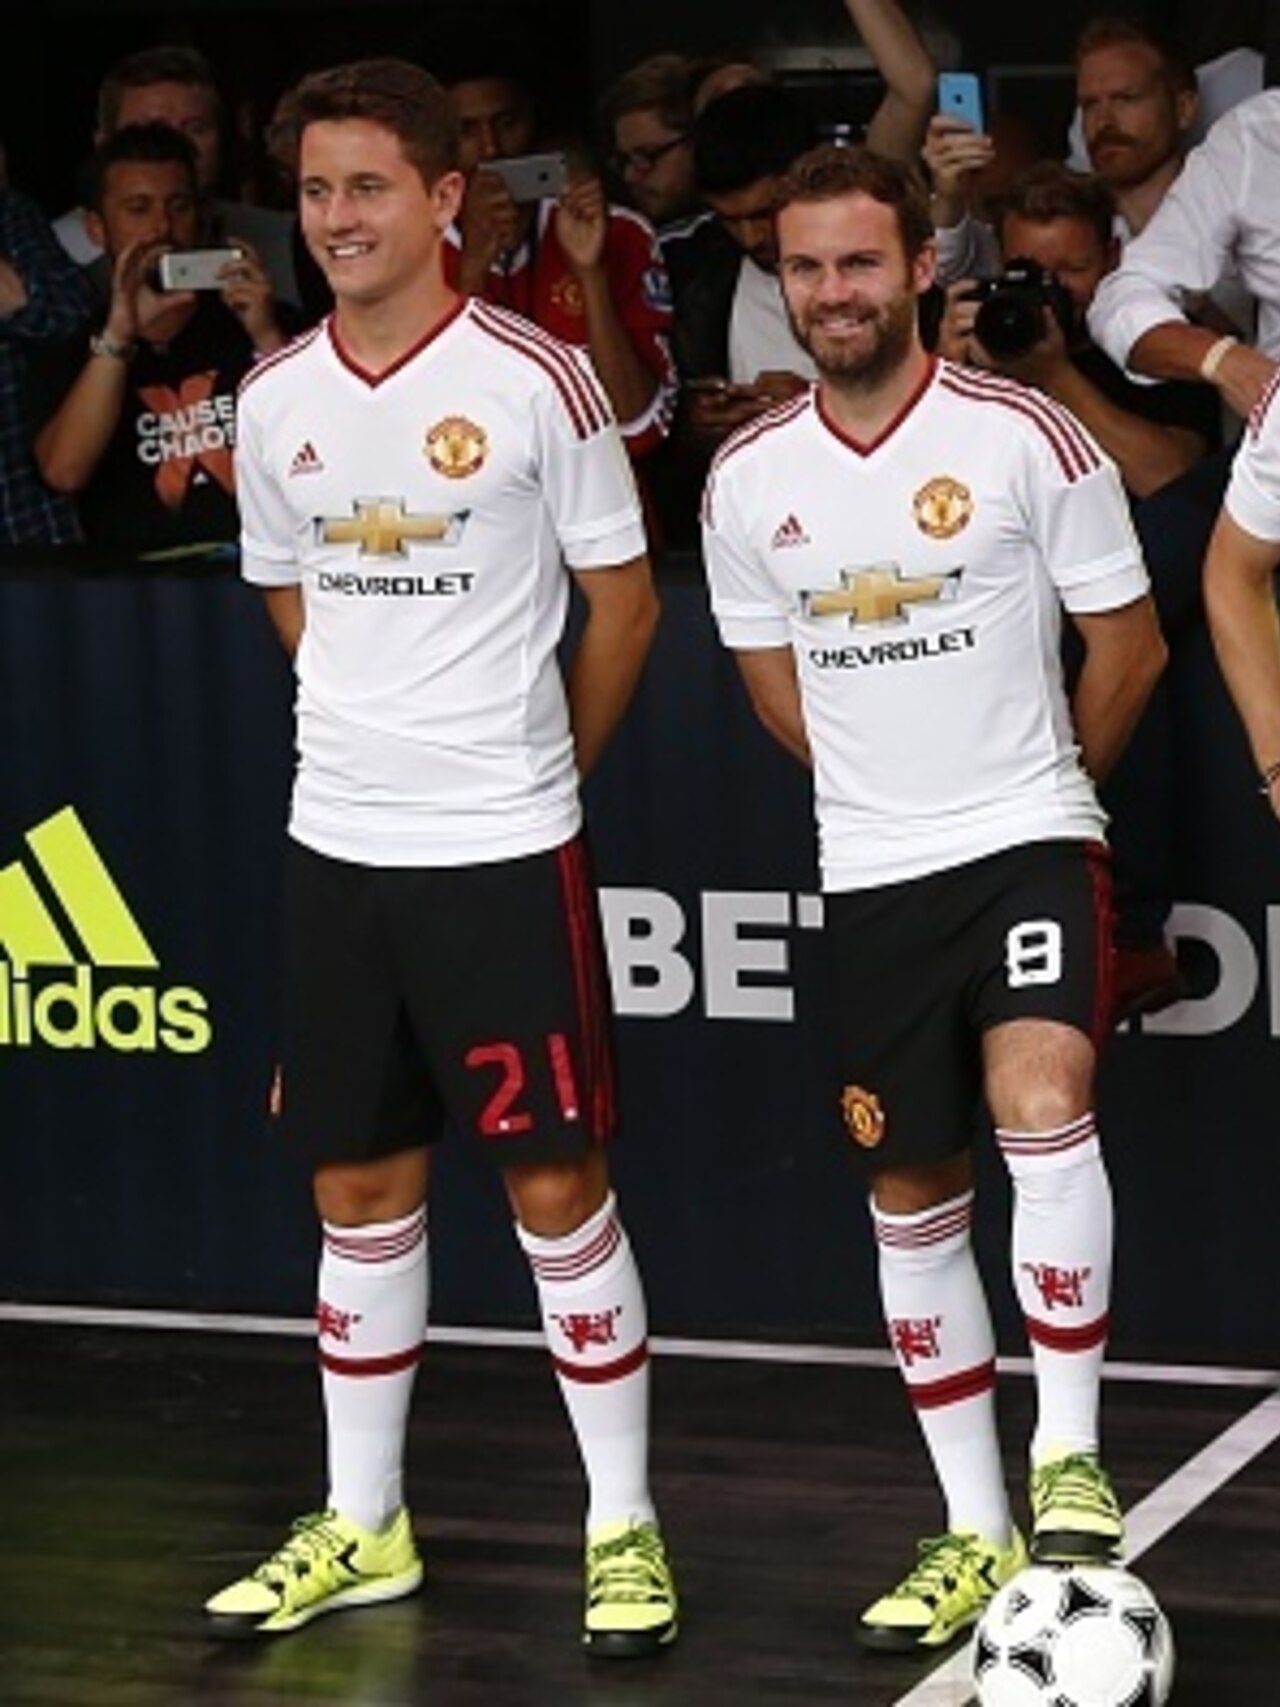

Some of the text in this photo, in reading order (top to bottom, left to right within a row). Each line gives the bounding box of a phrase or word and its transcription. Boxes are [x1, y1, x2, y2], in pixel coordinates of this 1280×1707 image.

[136, 395, 234, 437] CAUSE
[1004, 920, 1062, 988] 8
[464, 1033, 578, 1135] 21
